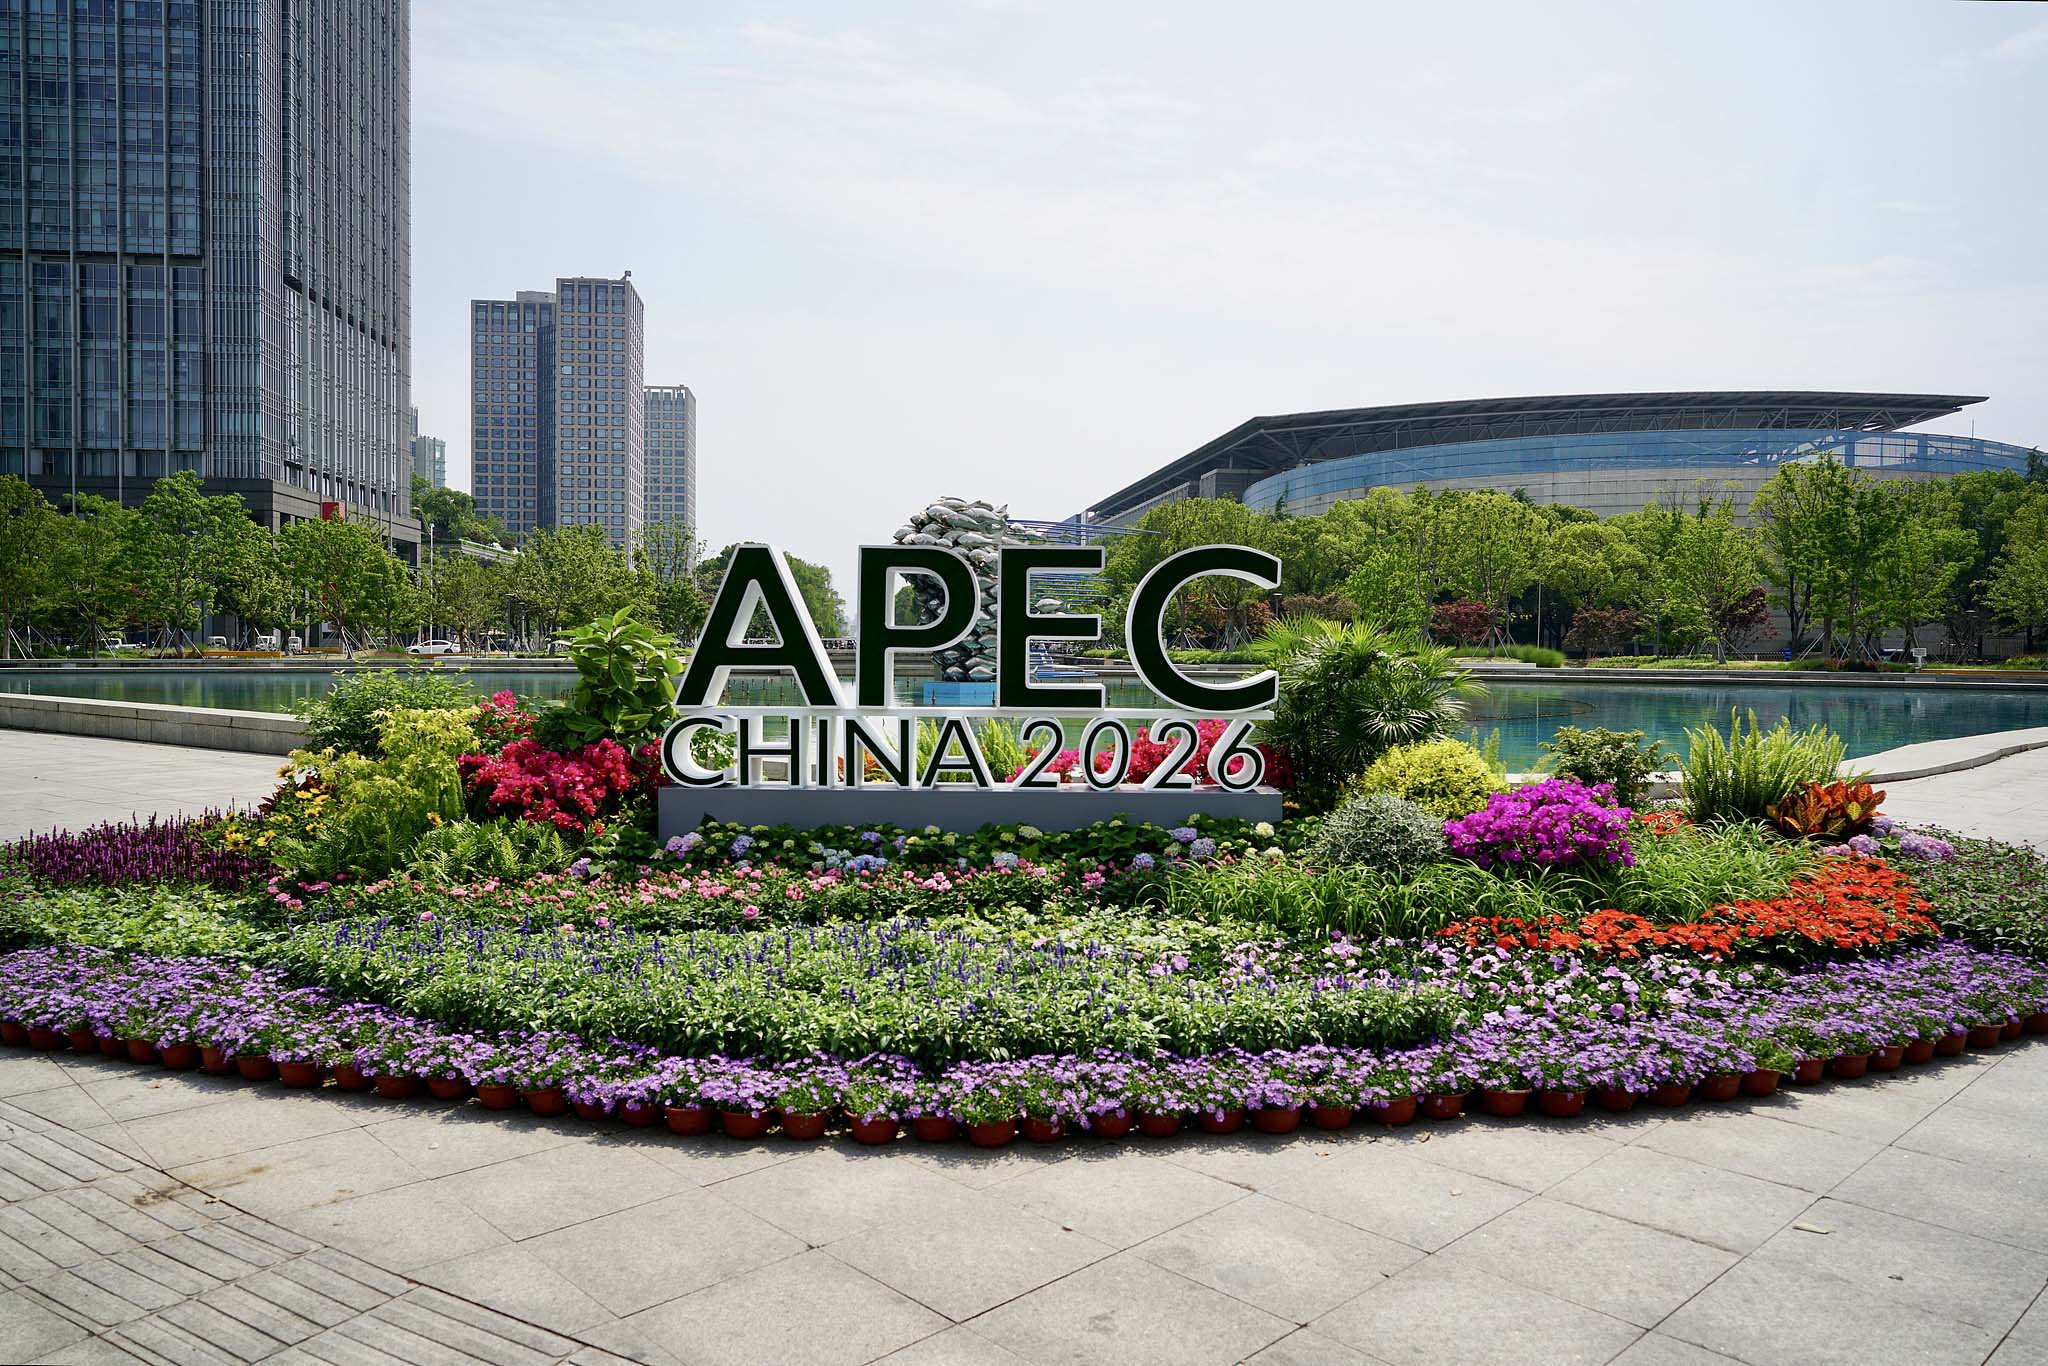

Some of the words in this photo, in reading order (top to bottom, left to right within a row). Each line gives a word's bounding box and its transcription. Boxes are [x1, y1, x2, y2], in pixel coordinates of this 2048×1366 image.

[674, 543, 1281, 712] APEC
[661, 715, 993, 788] CHINA
[1016, 717, 1265, 792] 2026
